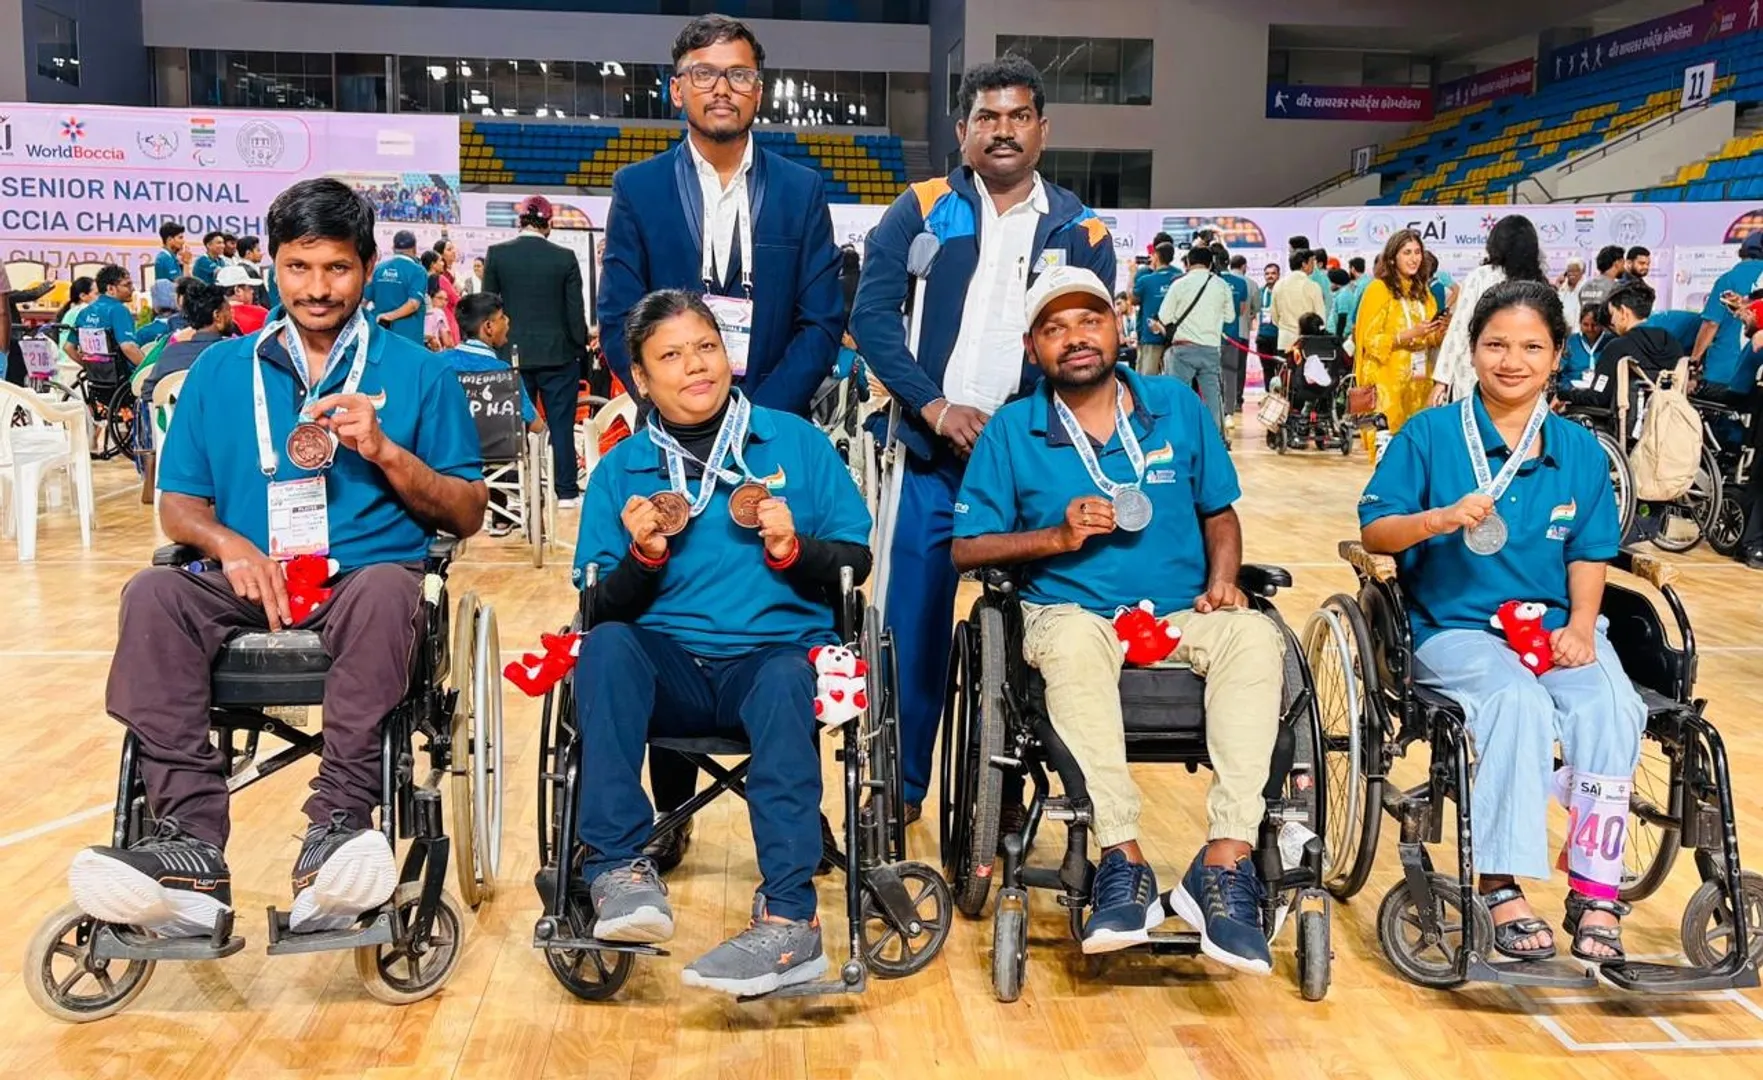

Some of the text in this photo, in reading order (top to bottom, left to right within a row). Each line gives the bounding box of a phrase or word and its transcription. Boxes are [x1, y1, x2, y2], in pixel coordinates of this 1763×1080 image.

[1688, 70, 1705, 100] 11
[26, 144, 125, 160] WorldBoccia
[2, 177, 250, 203] SENIOR NATIONAL
[2, 209, 69, 231] CCIA
[1581, 782, 1601, 797] SAI
